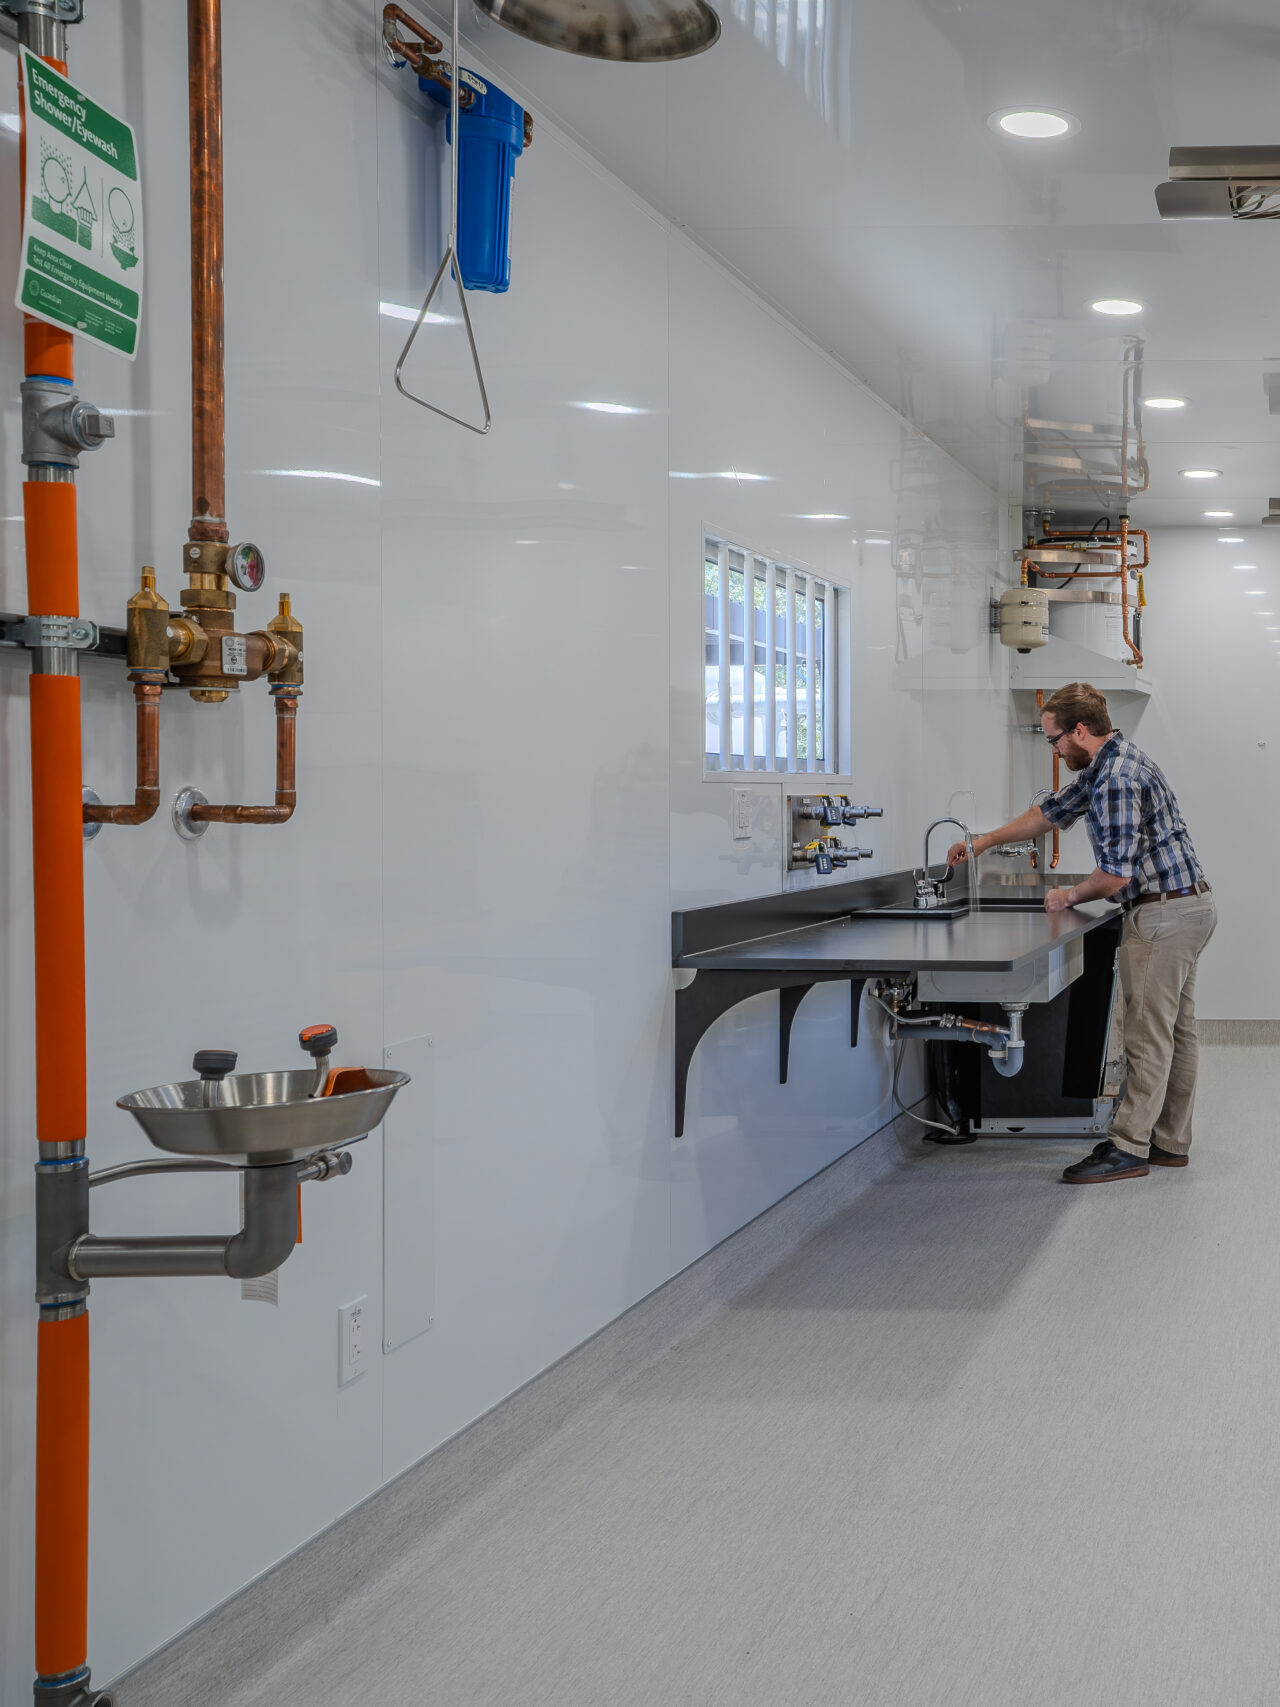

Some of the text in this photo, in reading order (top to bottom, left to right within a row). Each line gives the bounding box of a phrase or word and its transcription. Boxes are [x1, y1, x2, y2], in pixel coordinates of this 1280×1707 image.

[31, 68, 87, 121] Emergency
[34, 90, 118, 160] Shower/Eyewash
[33, 244, 73, 270] Keep Area Clear
[51, 264, 79, 286] Emergency
[78, 279, 105, 299] Equipment
[105, 293, 123, 309] Weekly
